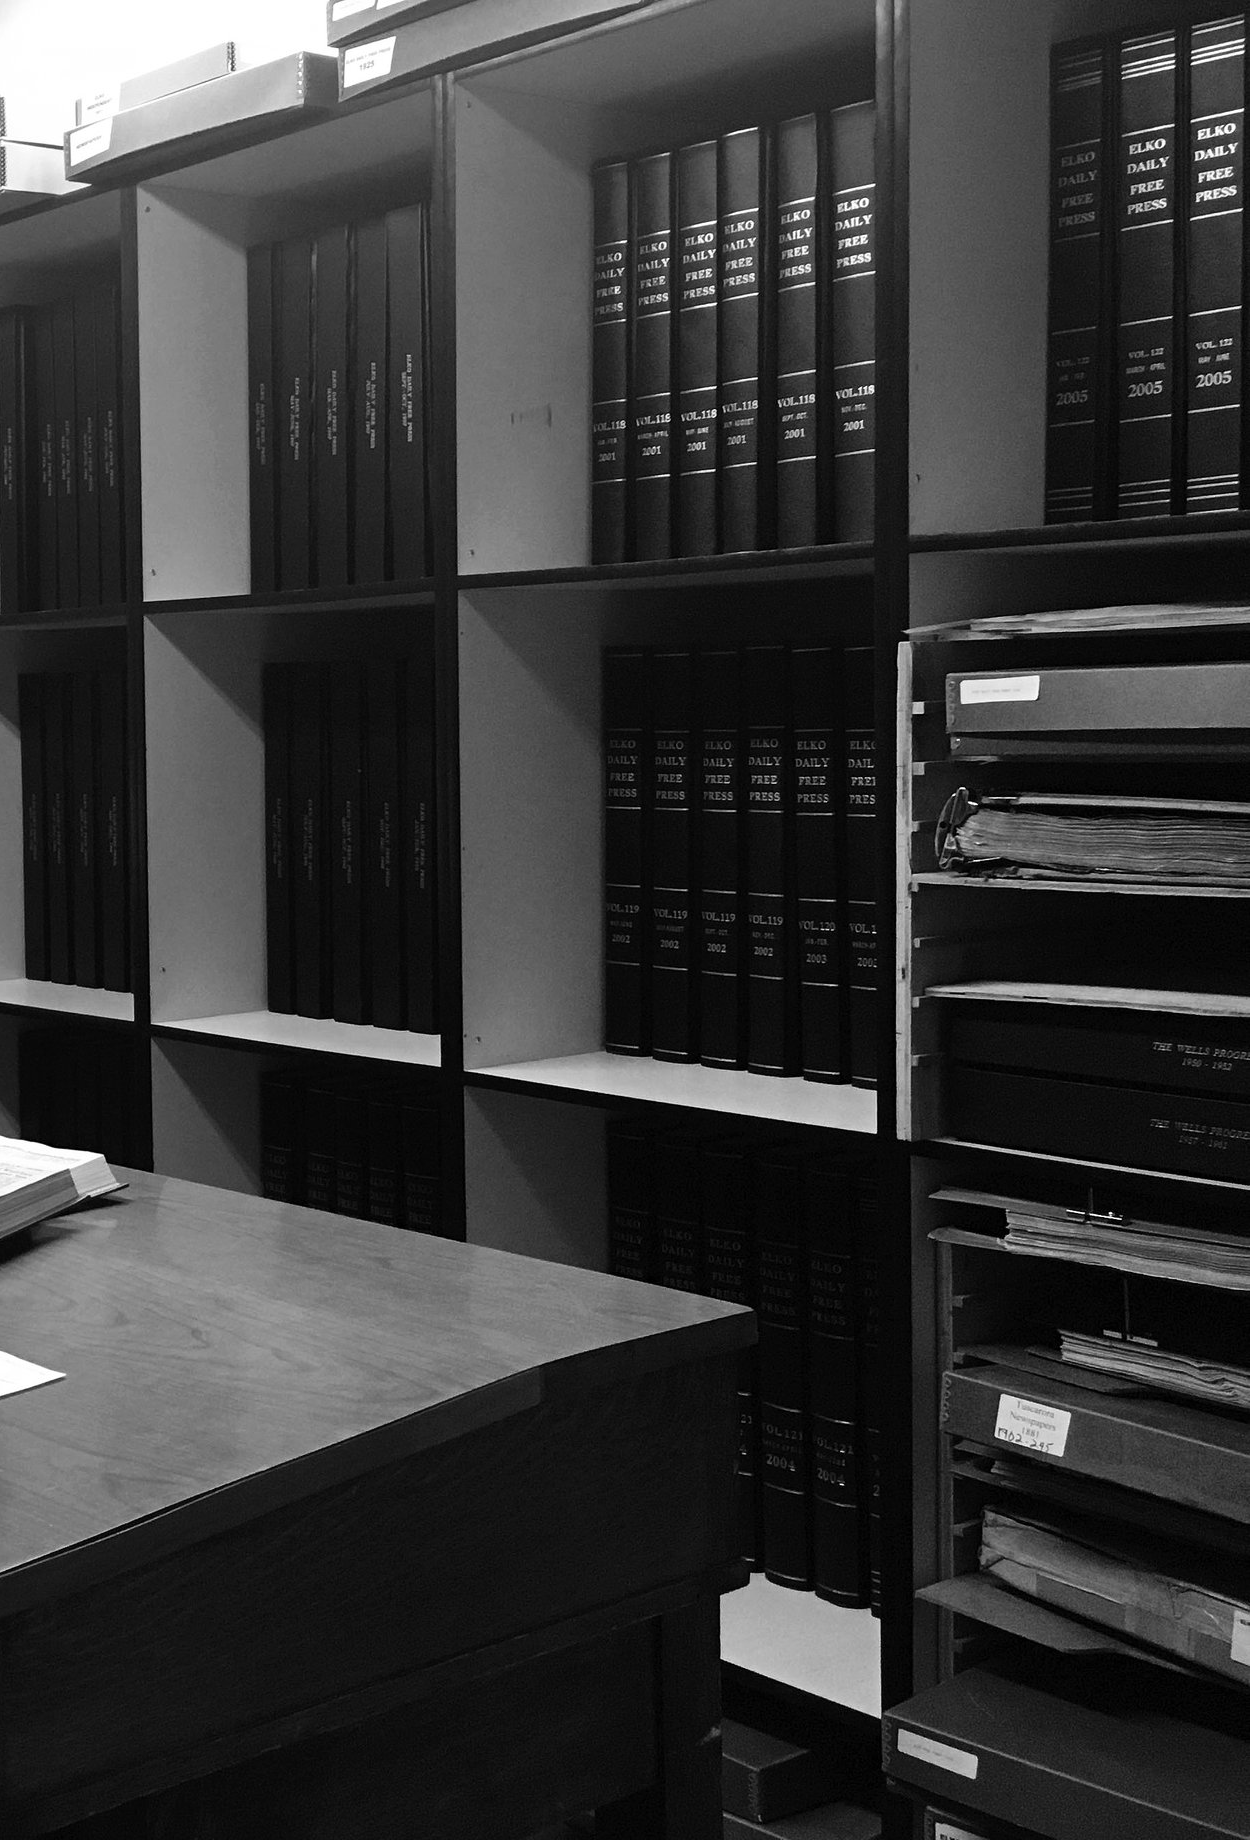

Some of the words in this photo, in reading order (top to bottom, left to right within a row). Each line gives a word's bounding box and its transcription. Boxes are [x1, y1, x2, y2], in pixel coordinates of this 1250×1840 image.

[1197, 123, 1236, 140] ELKO
[1129, 138, 1166, 155] ELKO
[1194, 142, 1238, 162] DAILY
[1061, 151, 1096, 167] ELKO
[1127, 156, 1169, 174] DAILY
[1058, 170, 1097, 187] DAILY
[1198, 166, 1234, 183] FREE
[1130, 179, 1164, 196] FREE
[1195, 185, 1237, 202] PRESS
[837, 197, 870, 214] ELKO
[1061, 193, 1093, 208] FREE
[1127, 198, 1167, 215] PRESS
[780, 209, 811, 224] ELKO
[835, 214, 872, 231] DAILY
[1058, 211, 1095, 227] PRESS
[724, 220, 754, 234] ELKO
[685, 232, 714, 246] ELKO
[778, 227, 813, 243] DAILY
[838, 234, 869, 249] FREE
[640, 241, 667, 254] ELKO
[722, 237, 757, 252] DAILY
[596, 252, 623, 264] ELKO
[683, 249, 717, 264] DAILY
[781, 245, 809, 260] FREE
[638, 257, 670, 271] DAILY
[725, 256, 753, 270] FREE
[836, 252, 872, 269] PRESS
[595, 268, 625, 280] DAILY
[685, 268, 713, 281] FREE
[779, 263, 812, 279] PRESS
[640, 276, 666, 289] FREE
[723, 273, 756, 287] PRESS
[597, 285, 621, 297] FREE
[683, 285, 715, 300] PRESS
[638, 293, 669, 306] PRESS
[595, 302, 624, 315] PRESS
[1195, 370, 1232, 388] 2005
[835, 385, 875, 399] VOL.118
[1127, 380, 1164, 398] 2005
[843, 420, 865, 432] 2001
[726, 435, 747, 446] 2001
[784, 428, 805, 440] 2001
[642, 446, 661, 456] 2001
[687, 441, 706, 452] 2001
[657, 740, 684, 750] ELKO
[705, 740, 731, 750] ELKO
[750, 738, 779, 748] ELKO
[797, 740, 827, 750] ELKO
[655, 756, 687, 766] DAILY
[703, 757, 734, 767] DAILY
[748, 756, 782, 766] DAILY
[795, 757, 830, 767] DAILY
[847, 758, 875, 768] DAIL
[657, 773, 683, 783] FREE
[704, 774, 731, 784] FREE
[750, 775, 778, 785] FREE
[798, 776, 827, 786] FREE
[656, 790, 685, 800] PRESS
[703, 791, 733, 801] PRESS
[749, 791, 781, 801] PRESS
[797, 793, 830, 803] PRESS
[849, 794, 876, 805] PRES
[660, 939, 679, 949] 2002
[707, 943, 727, 953] 2002
[753, 946, 773, 956] 2002
[1152, 1041, 1173, 1052] THE
[1177, 1044, 1210, 1056] WELLS
[1017, 1401, 1054, 1418] Tuscarora
[1011, 1411, 1056, 1431] Newspapers
